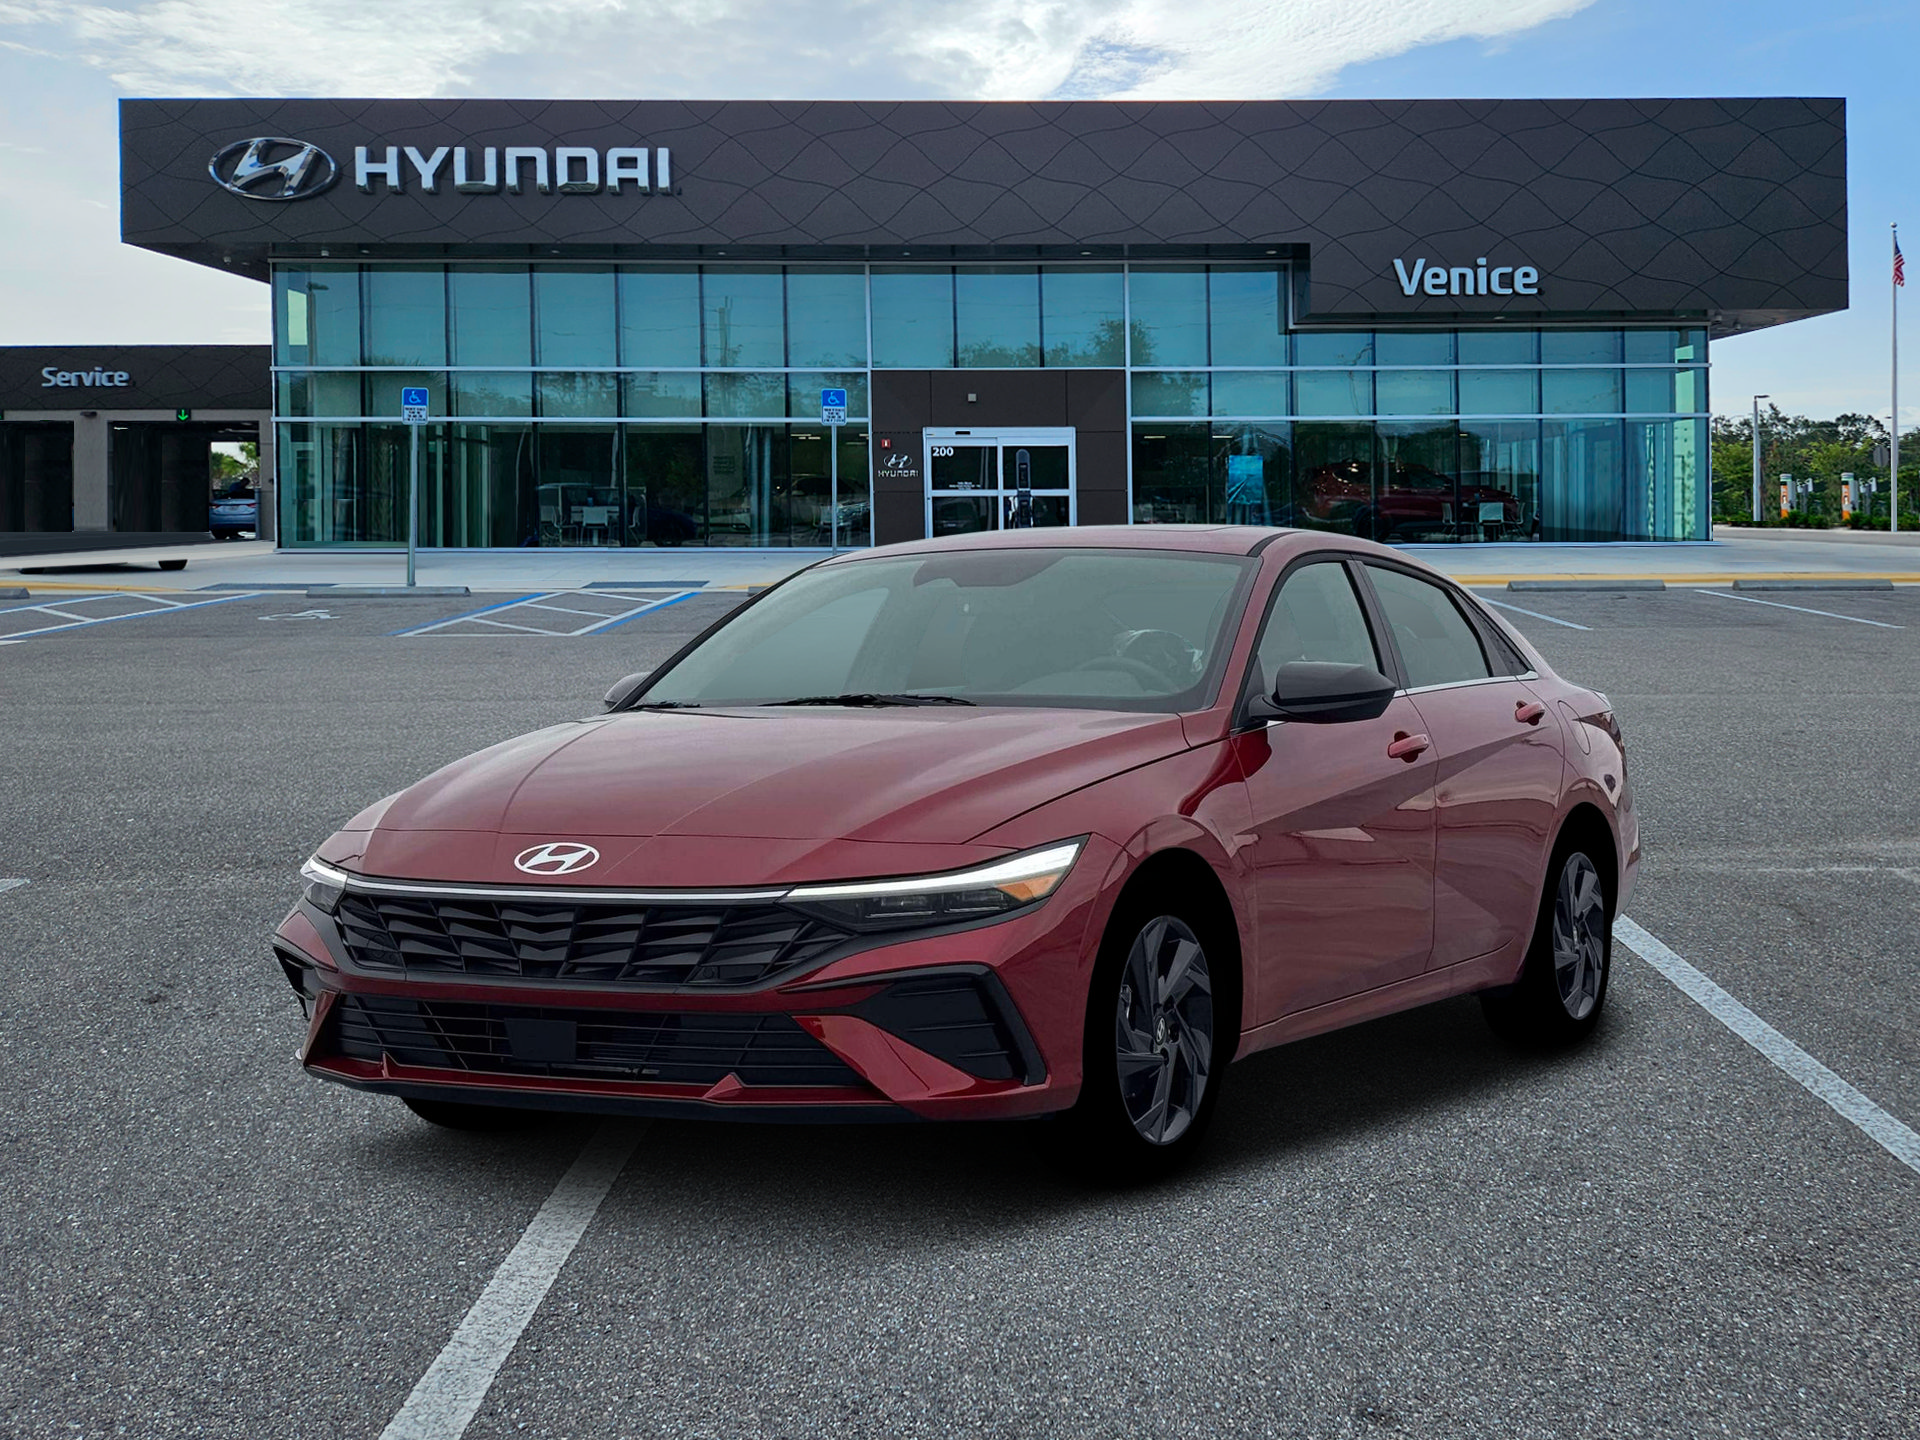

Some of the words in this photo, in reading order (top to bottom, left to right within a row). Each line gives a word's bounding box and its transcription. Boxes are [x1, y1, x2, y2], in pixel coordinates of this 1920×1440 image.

[355, 146, 670, 193] HYUNDAI
[1393, 257, 1539, 296] Venice
[41, 366, 130, 387] Service
[932, 446, 954, 457] 200
[877, 469, 919, 478] HYUNDAI
